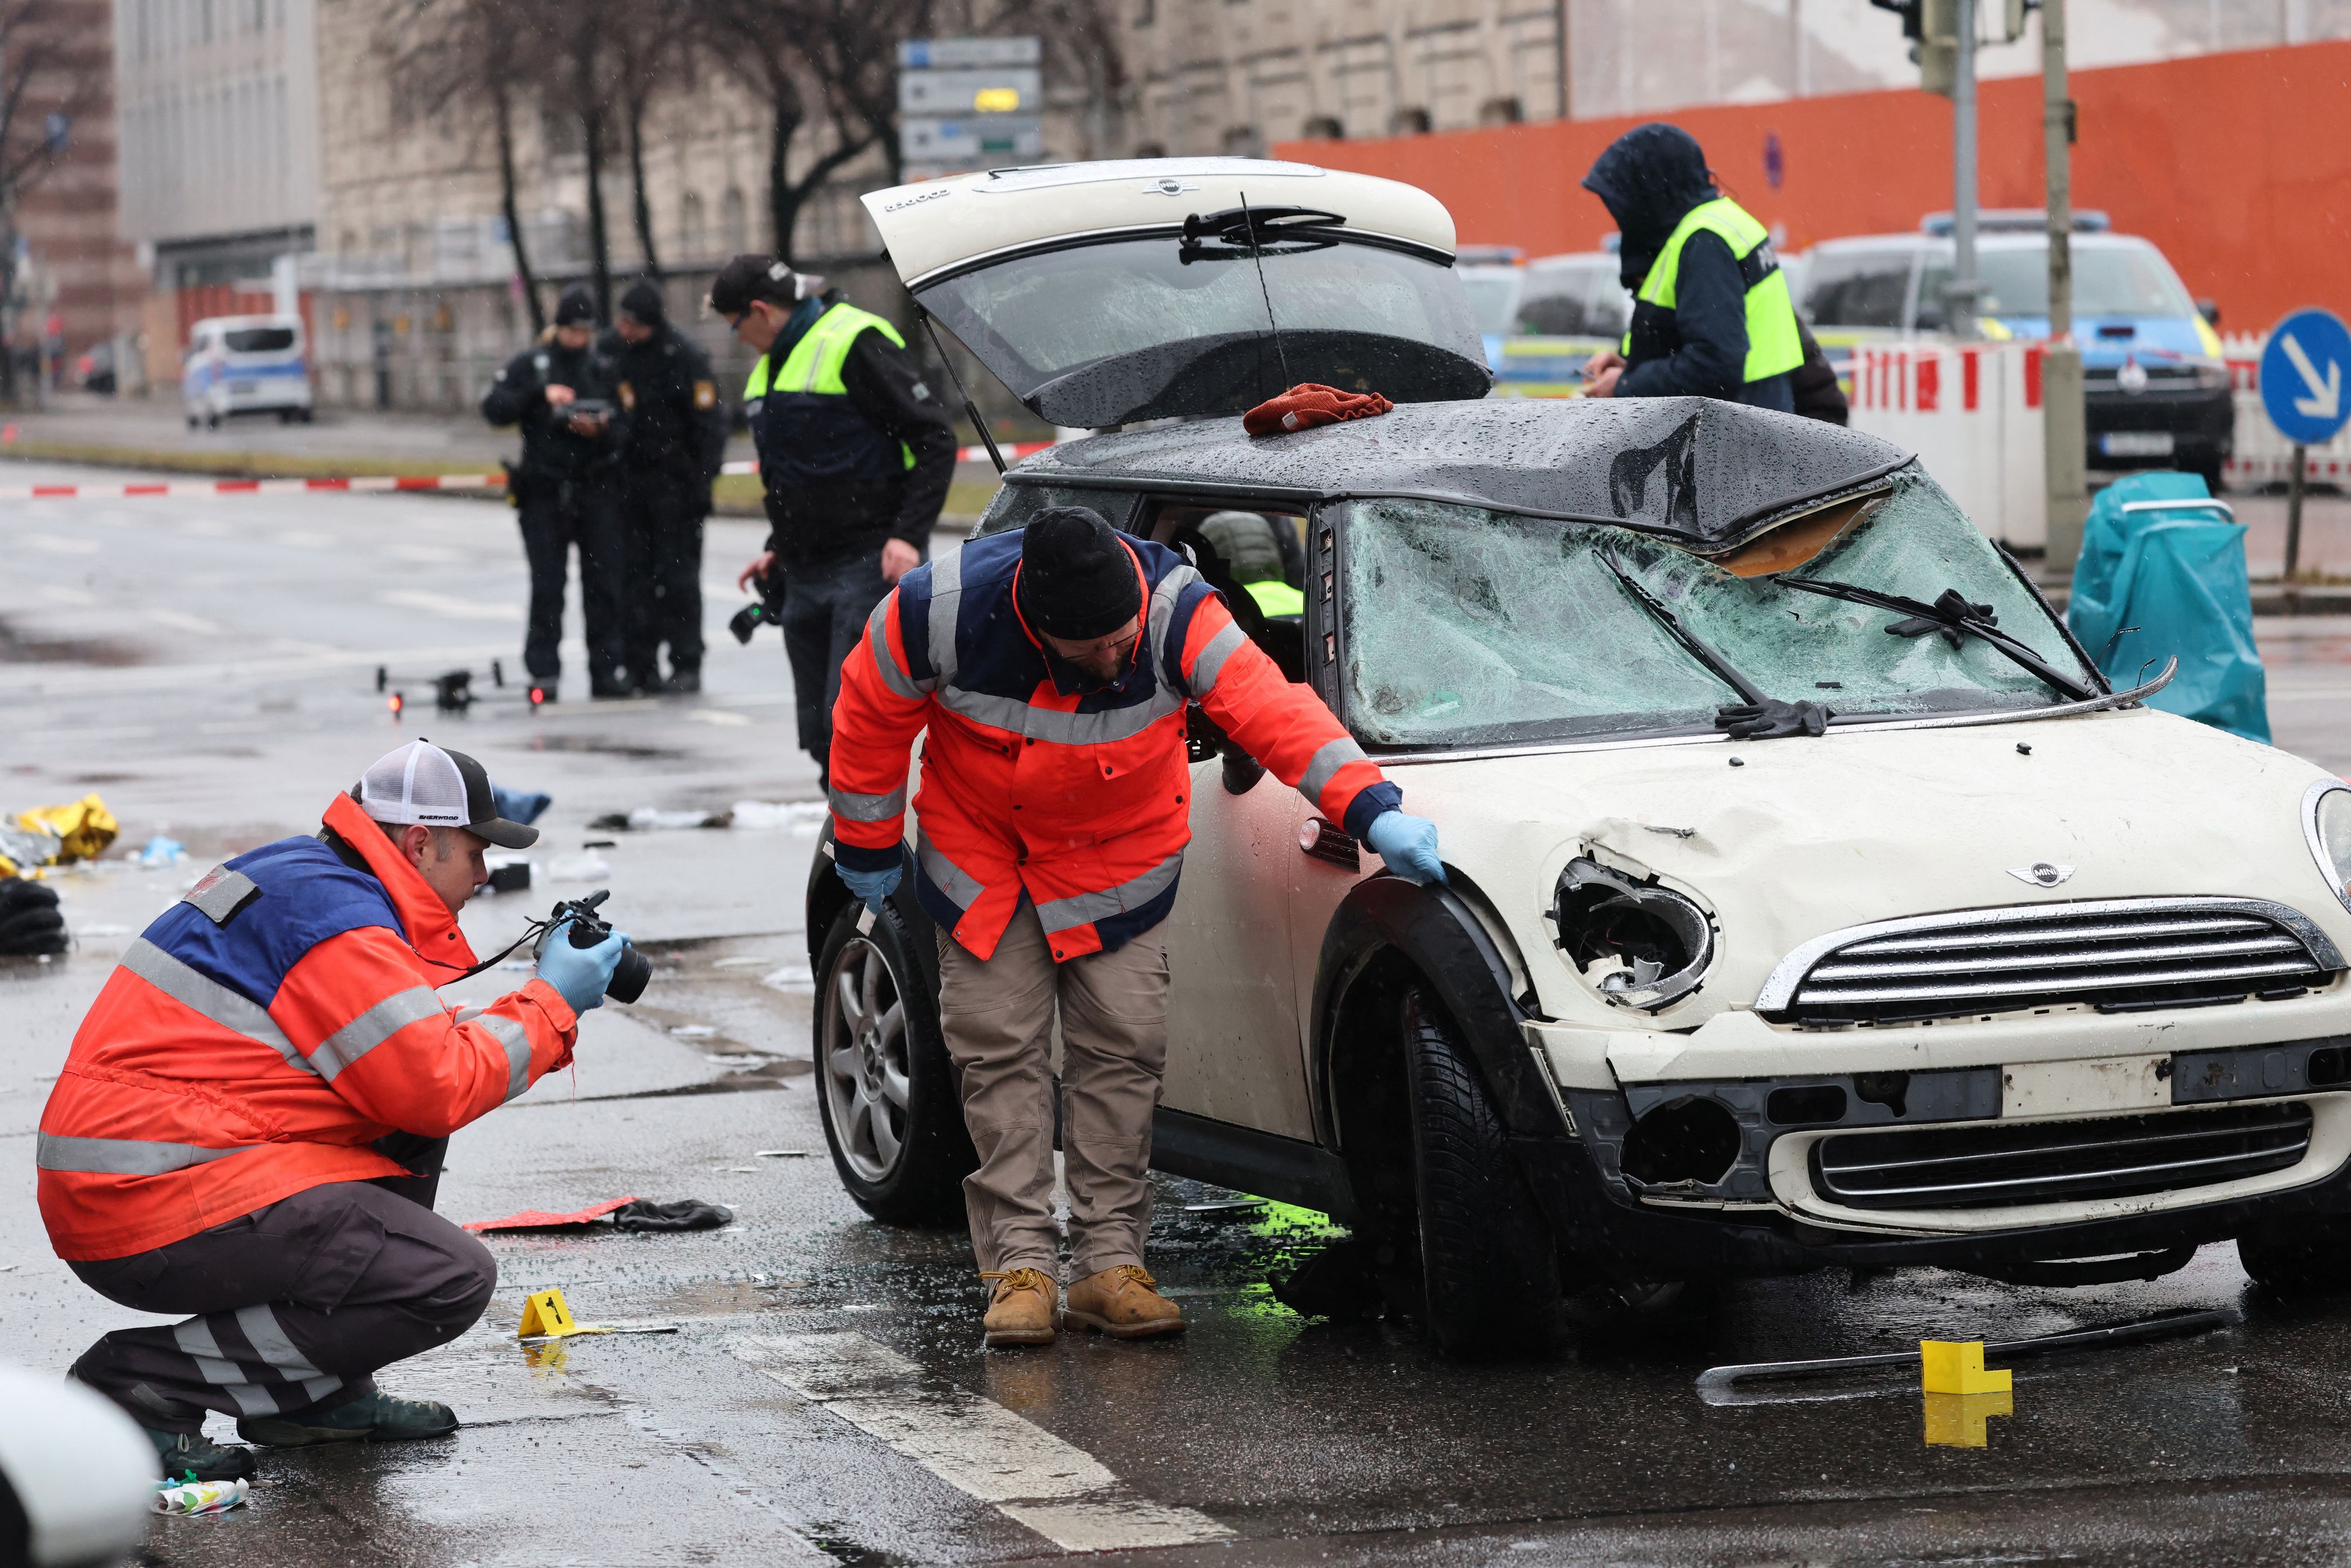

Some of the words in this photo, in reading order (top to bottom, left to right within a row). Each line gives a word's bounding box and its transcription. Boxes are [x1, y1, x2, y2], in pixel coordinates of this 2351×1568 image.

[885, 189, 950, 212] COOPER
[2034, 867, 2057, 876] MINI
[545, 1296, 562, 1324] 1
